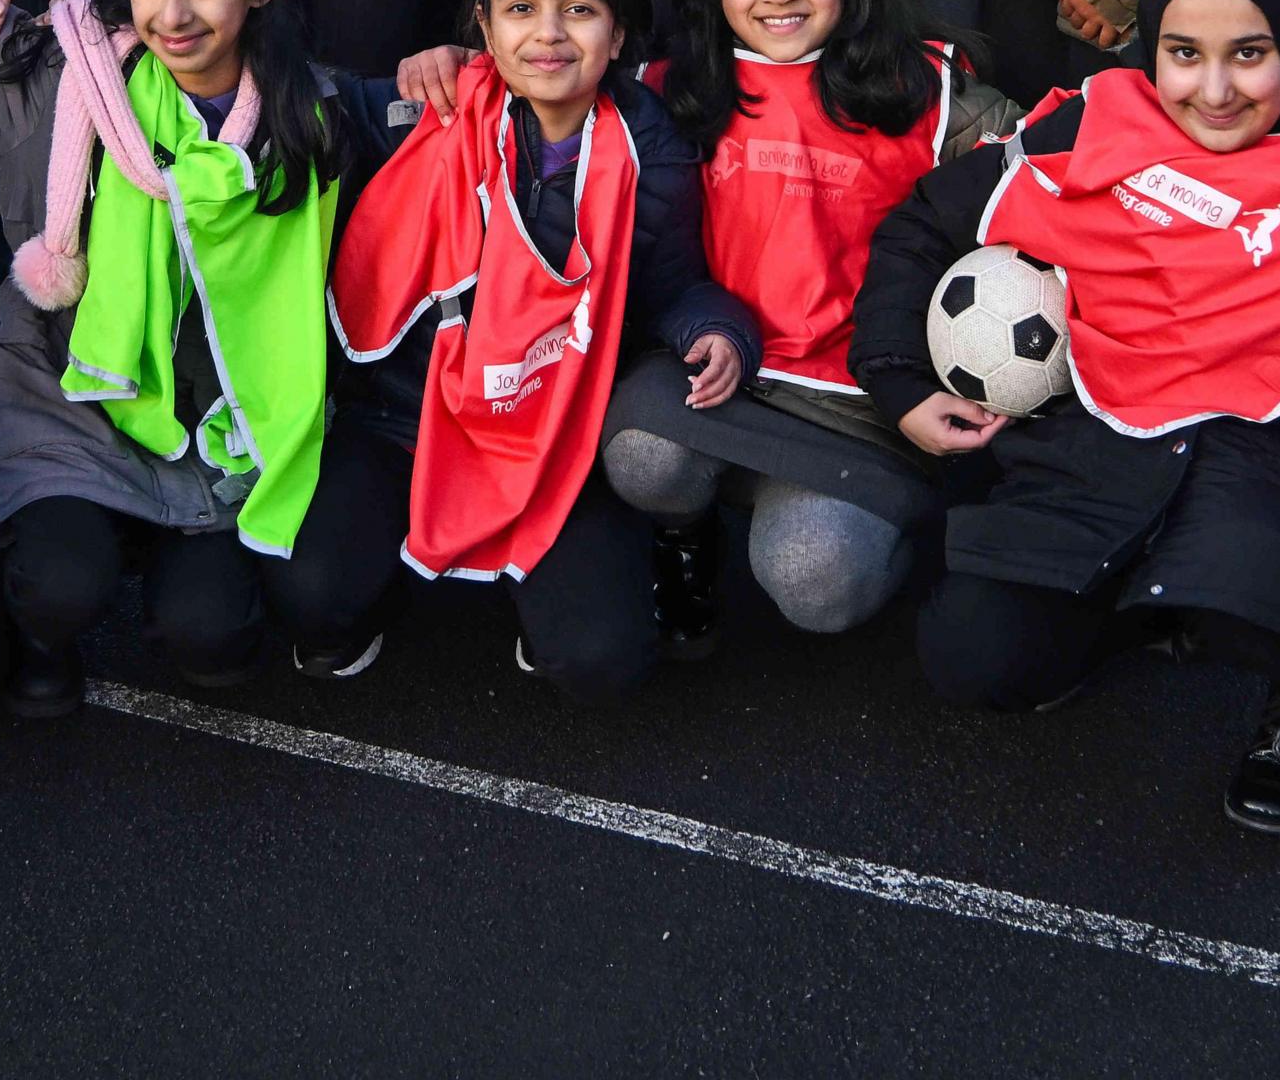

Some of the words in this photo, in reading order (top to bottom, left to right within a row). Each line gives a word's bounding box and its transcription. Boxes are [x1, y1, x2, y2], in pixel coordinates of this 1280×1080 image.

[1146, 174, 1167, 191] of
[1169, 183, 1223, 222] moving
[494, 373, 520, 392] Joy
